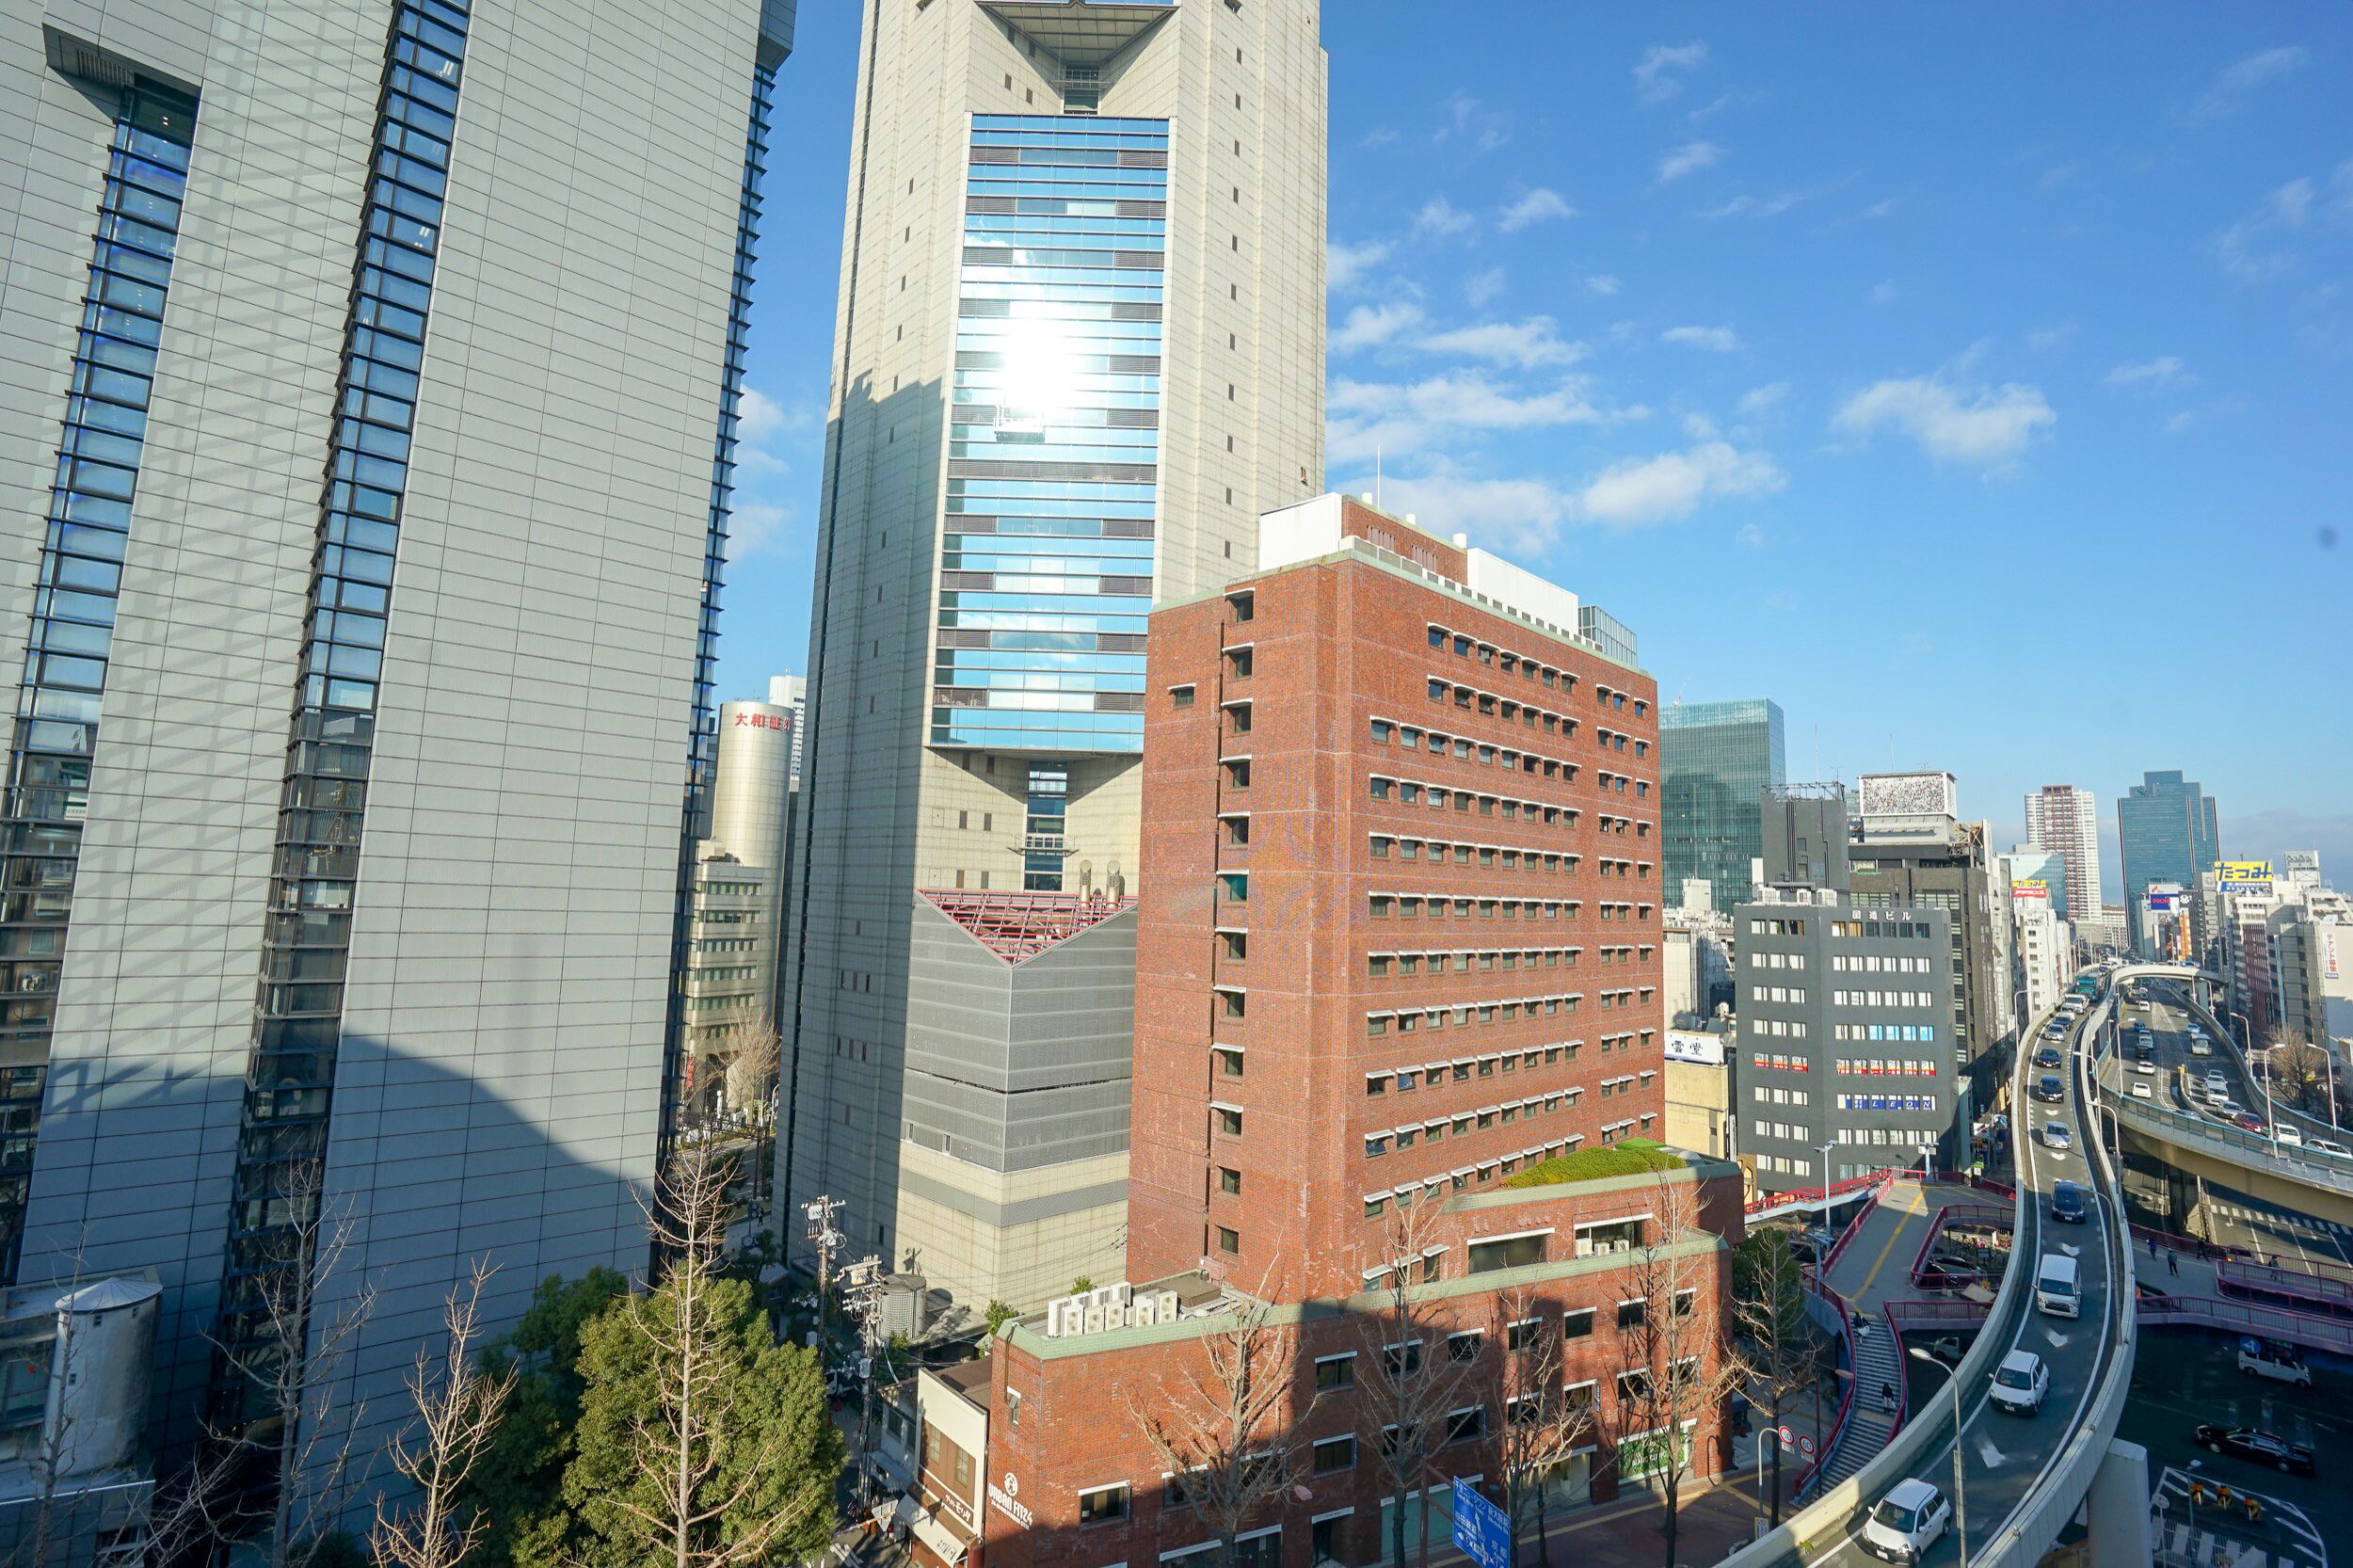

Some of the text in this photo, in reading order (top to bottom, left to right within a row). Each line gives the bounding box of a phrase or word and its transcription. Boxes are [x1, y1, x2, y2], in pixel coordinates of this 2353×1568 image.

[2215, 862, 2272, 881] たつみ
[988, 1482, 1013, 1512] URBAN
[1014, 1500, 1033, 1526] FIT24
